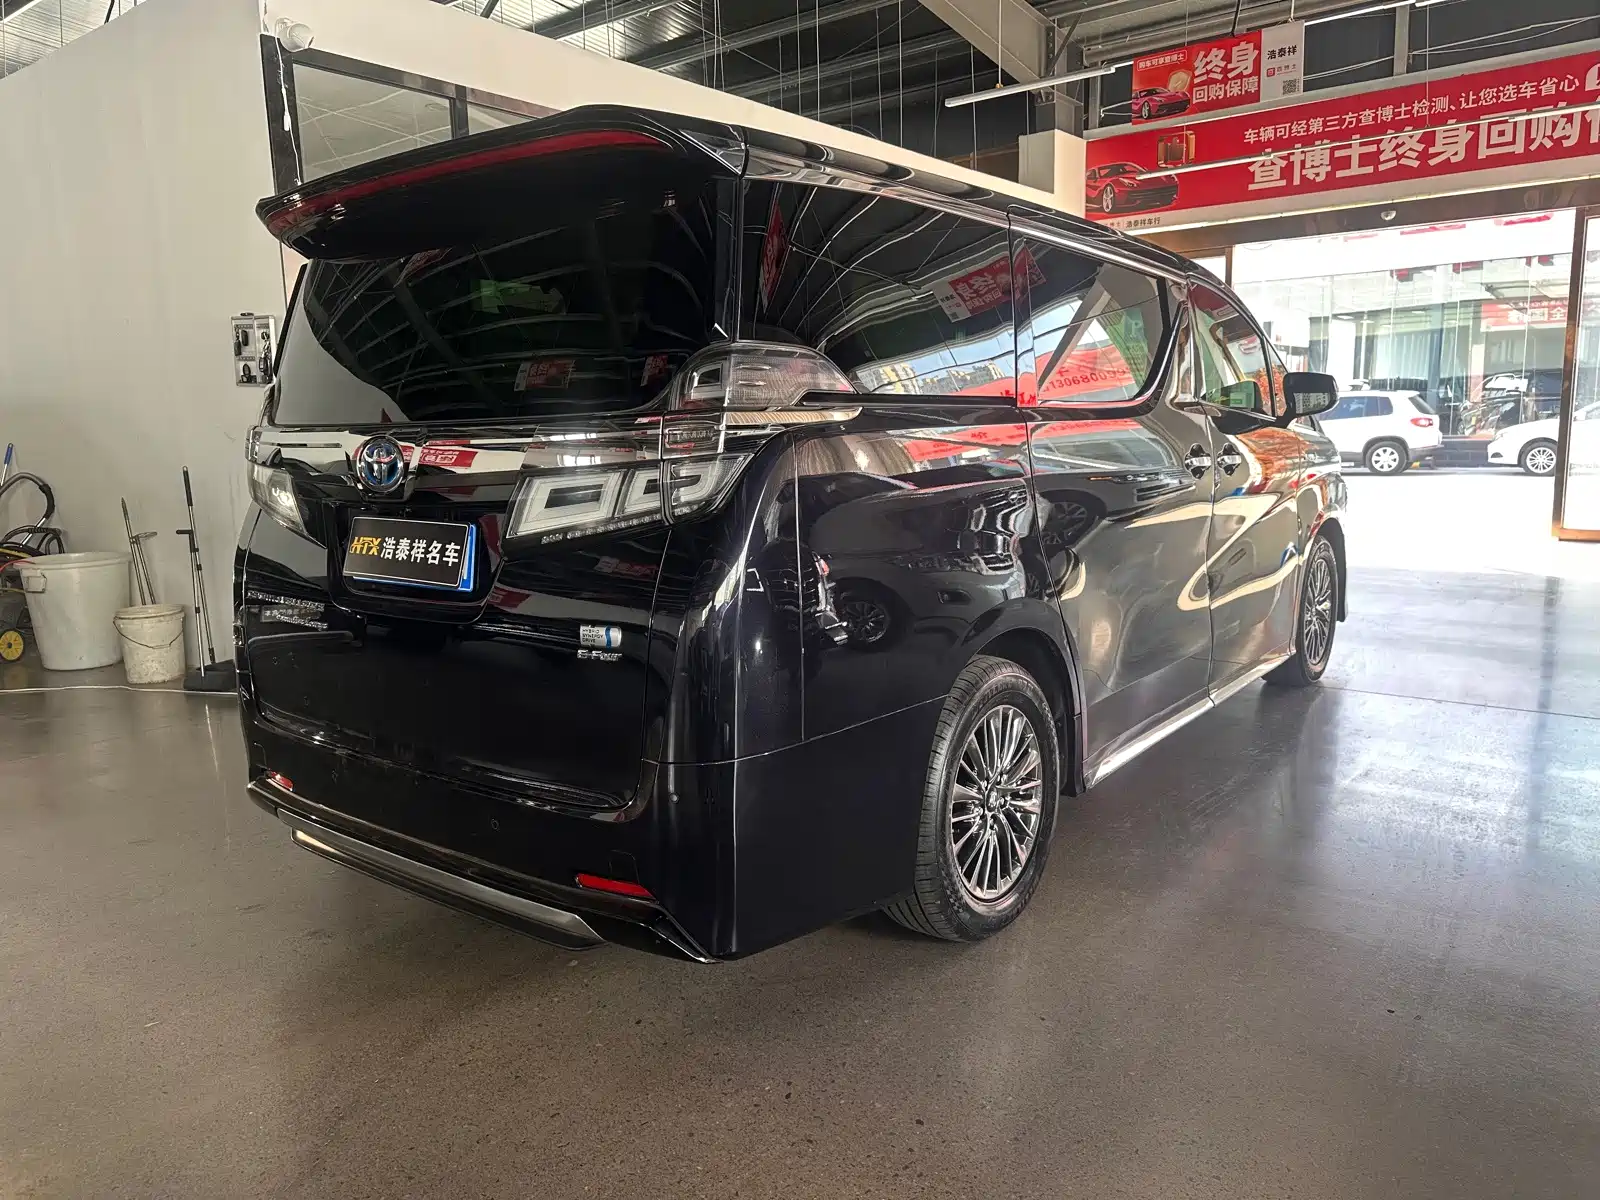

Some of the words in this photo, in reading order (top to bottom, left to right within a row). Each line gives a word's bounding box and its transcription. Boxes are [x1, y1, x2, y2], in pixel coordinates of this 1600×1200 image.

[1193, 40, 1259, 84] 终身
[1267, 45, 1297, 60] 浩泰祥
[1192, 75, 1259, 104] 回购保障
[1243, 74, 1580, 144] 车辆可经第三方查博士检测、让您选车省心
[1126, 217, 1160, 228] 浩泰祥车行
[380, 536, 461, 567] 浩泰祥名车
